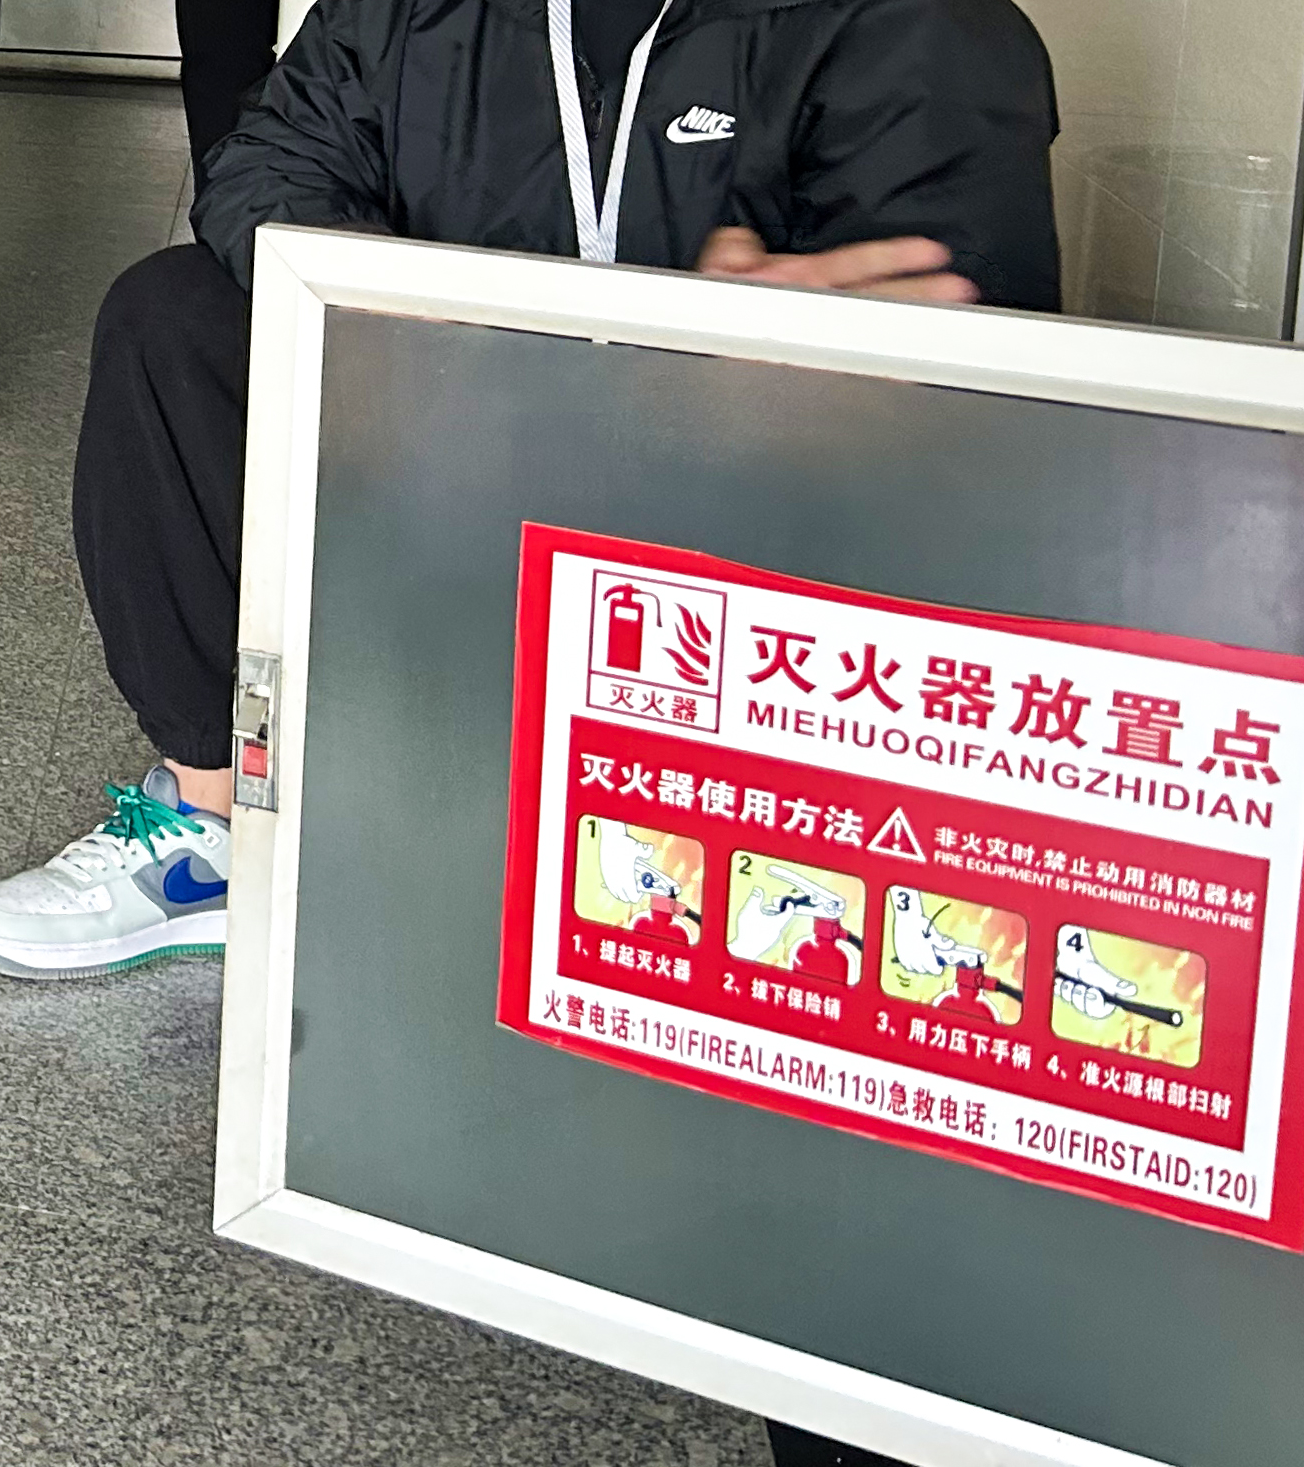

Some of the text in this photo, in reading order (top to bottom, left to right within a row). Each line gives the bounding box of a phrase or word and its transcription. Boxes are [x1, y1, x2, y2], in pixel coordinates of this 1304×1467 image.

[681, 105, 736, 134] NIKE
[609, 683, 698, 723] 灭火器
[746, 624, 1281, 785] 灭火器放置点
[746, 700, 1274, 829] MIEHUOQIFANGZHIDIAN
[579, 753, 864, 847] 灭火器使用方法
[587, 820, 596, 839] 1
[739, 855, 752, 876] 2
[896, 891, 910, 911] 3
[934, 850, 1254, 931] FIRE EQUIPMENT IS PROHIBITED IN NON FIRE
[1066, 932, 1084, 952] 4
